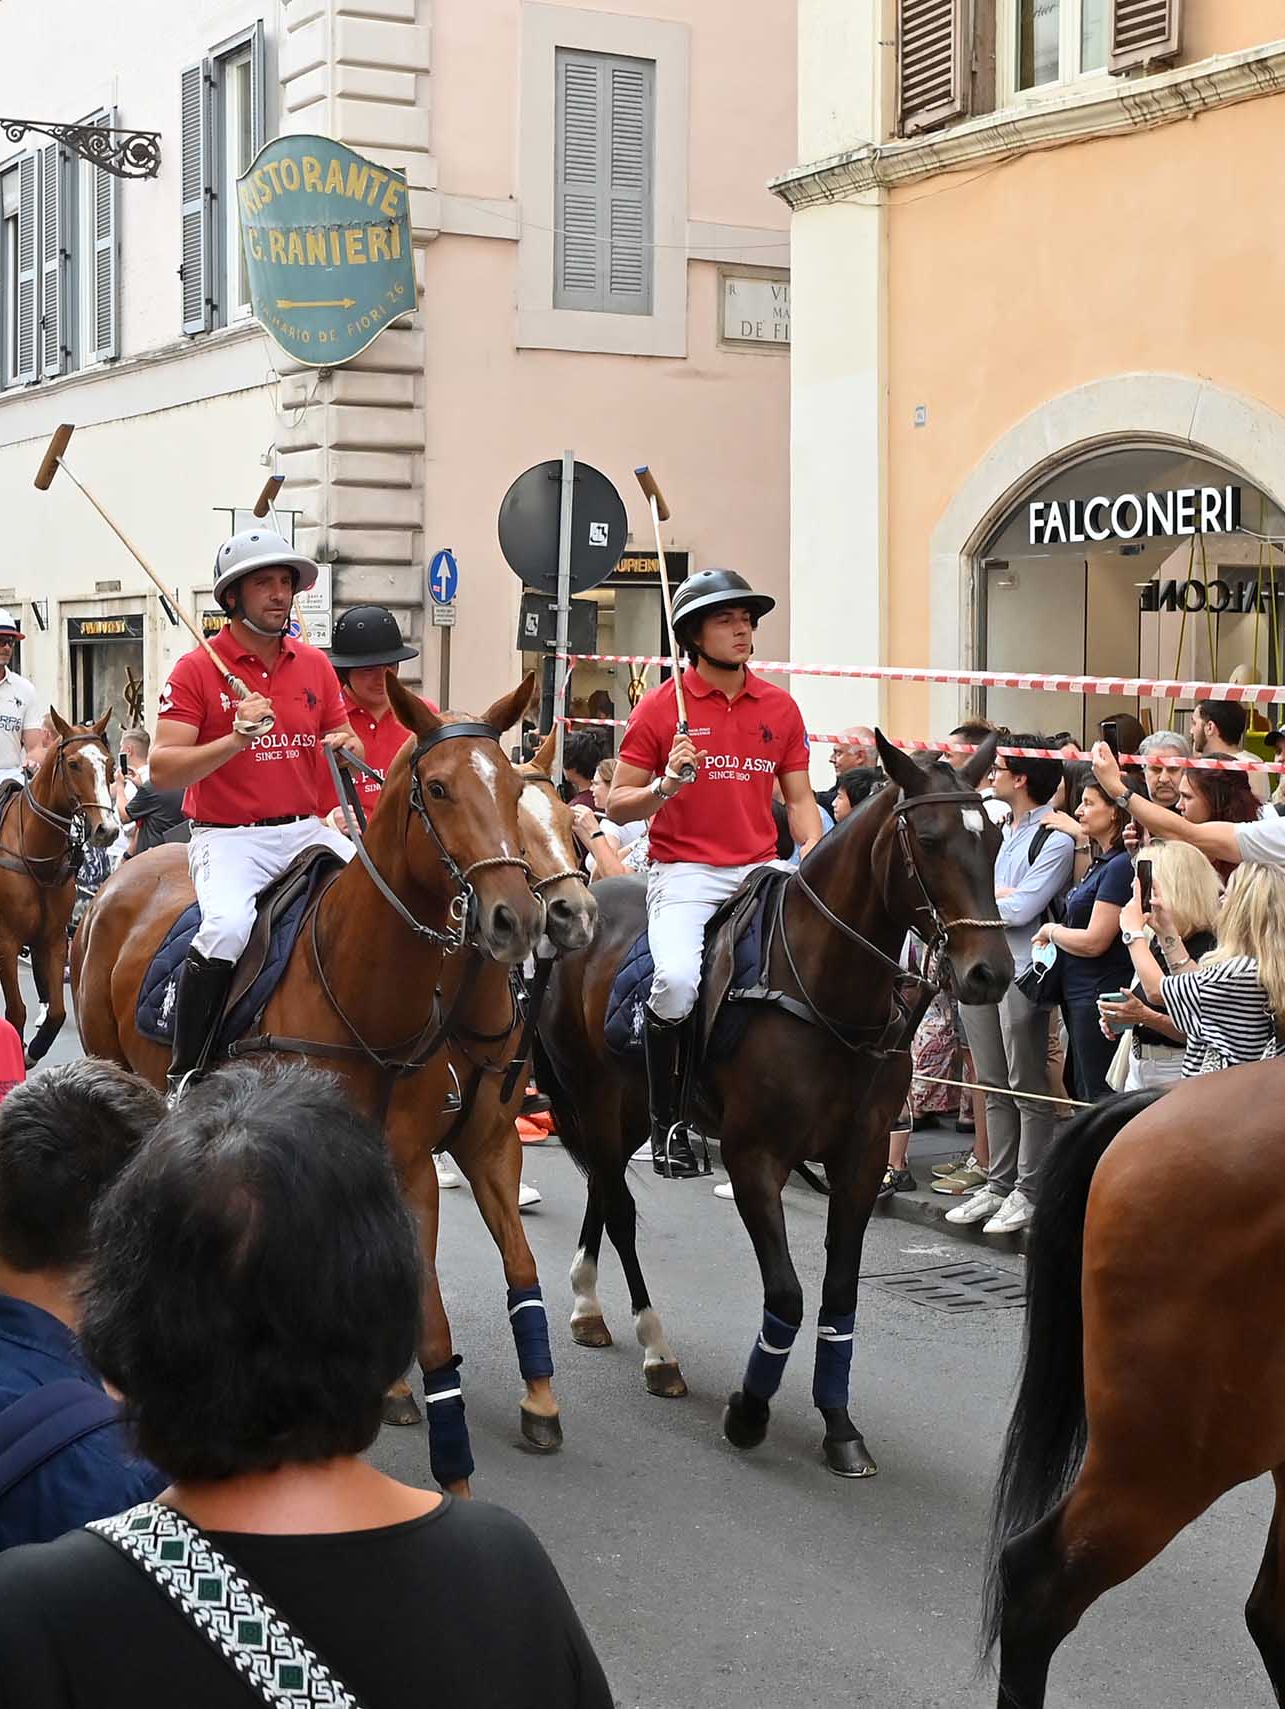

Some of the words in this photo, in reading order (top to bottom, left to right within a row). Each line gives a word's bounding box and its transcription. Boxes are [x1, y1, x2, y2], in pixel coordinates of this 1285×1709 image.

[238, 156, 404, 218] RISTORANTE
[771, 286, 789, 303] VI
[347, 303, 387, 336] FIORI
[386, 281, 404, 304] 26
[772, 306, 790, 319] MA
[774, 323, 789, 340] FI
[1029, 485, 1233, 545] FALCONERI
[251, 733, 289, 750] POLO
[255, 751, 283, 762] SINCE
[704, 755, 739, 769] POLO
[708, 770, 735, 780] SINCE
